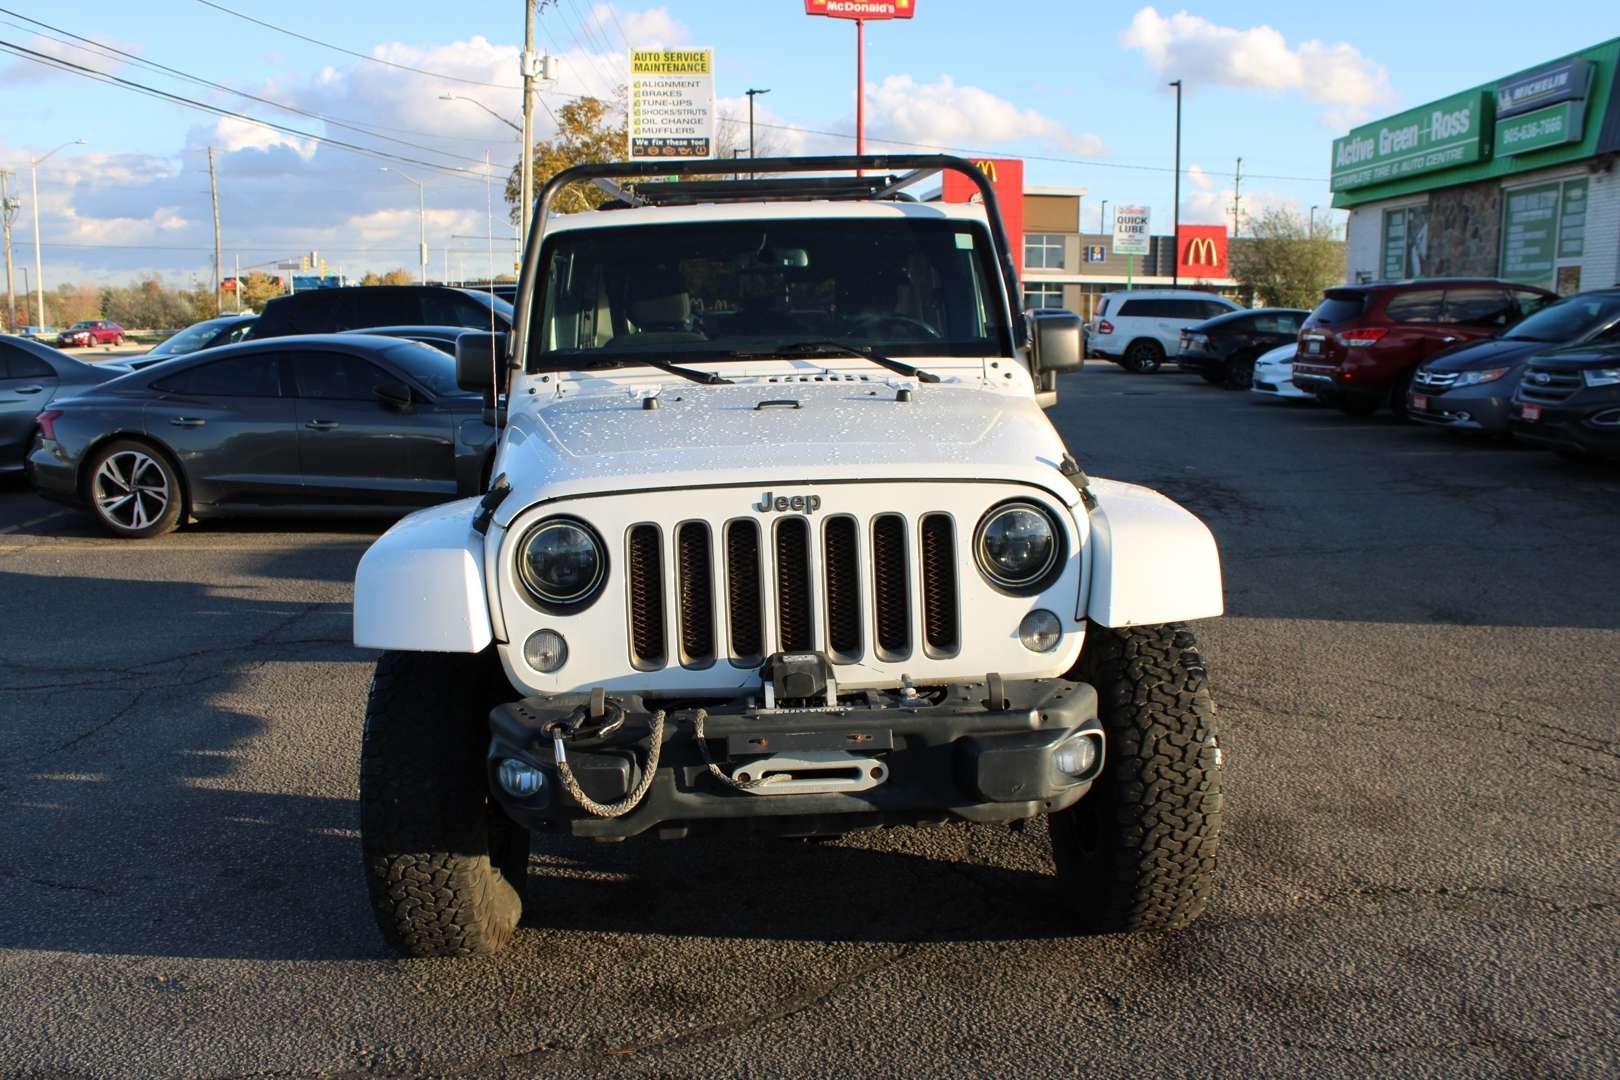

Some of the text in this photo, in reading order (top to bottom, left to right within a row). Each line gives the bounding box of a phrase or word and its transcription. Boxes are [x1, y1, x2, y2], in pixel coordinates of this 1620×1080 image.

[827, 2, 895, 13] McDonald's
[634, 52, 705, 62] AUTO SERVICE
[634, 63, 706, 72] MAINTENANCE
[1513, 73, 1569, 99] MICHELIN
[1336, 136, 1375, 167] Active
[1379, 124, 1418, 156] Green
[1431, 108, 1470, 141] Ross
[1335, 169, 1372, 187] COMPLETE
[1374, 165, 1391, 177] TIRE
[1400, 157, 1425, 172] AUTO
[1426, 147, 1465, 166] CENTRE
[1117, 216, 1148, 225] QUICK
[1119, 225, 1145, 234] LUBE
[751, 491, 821, 514] Jeep
